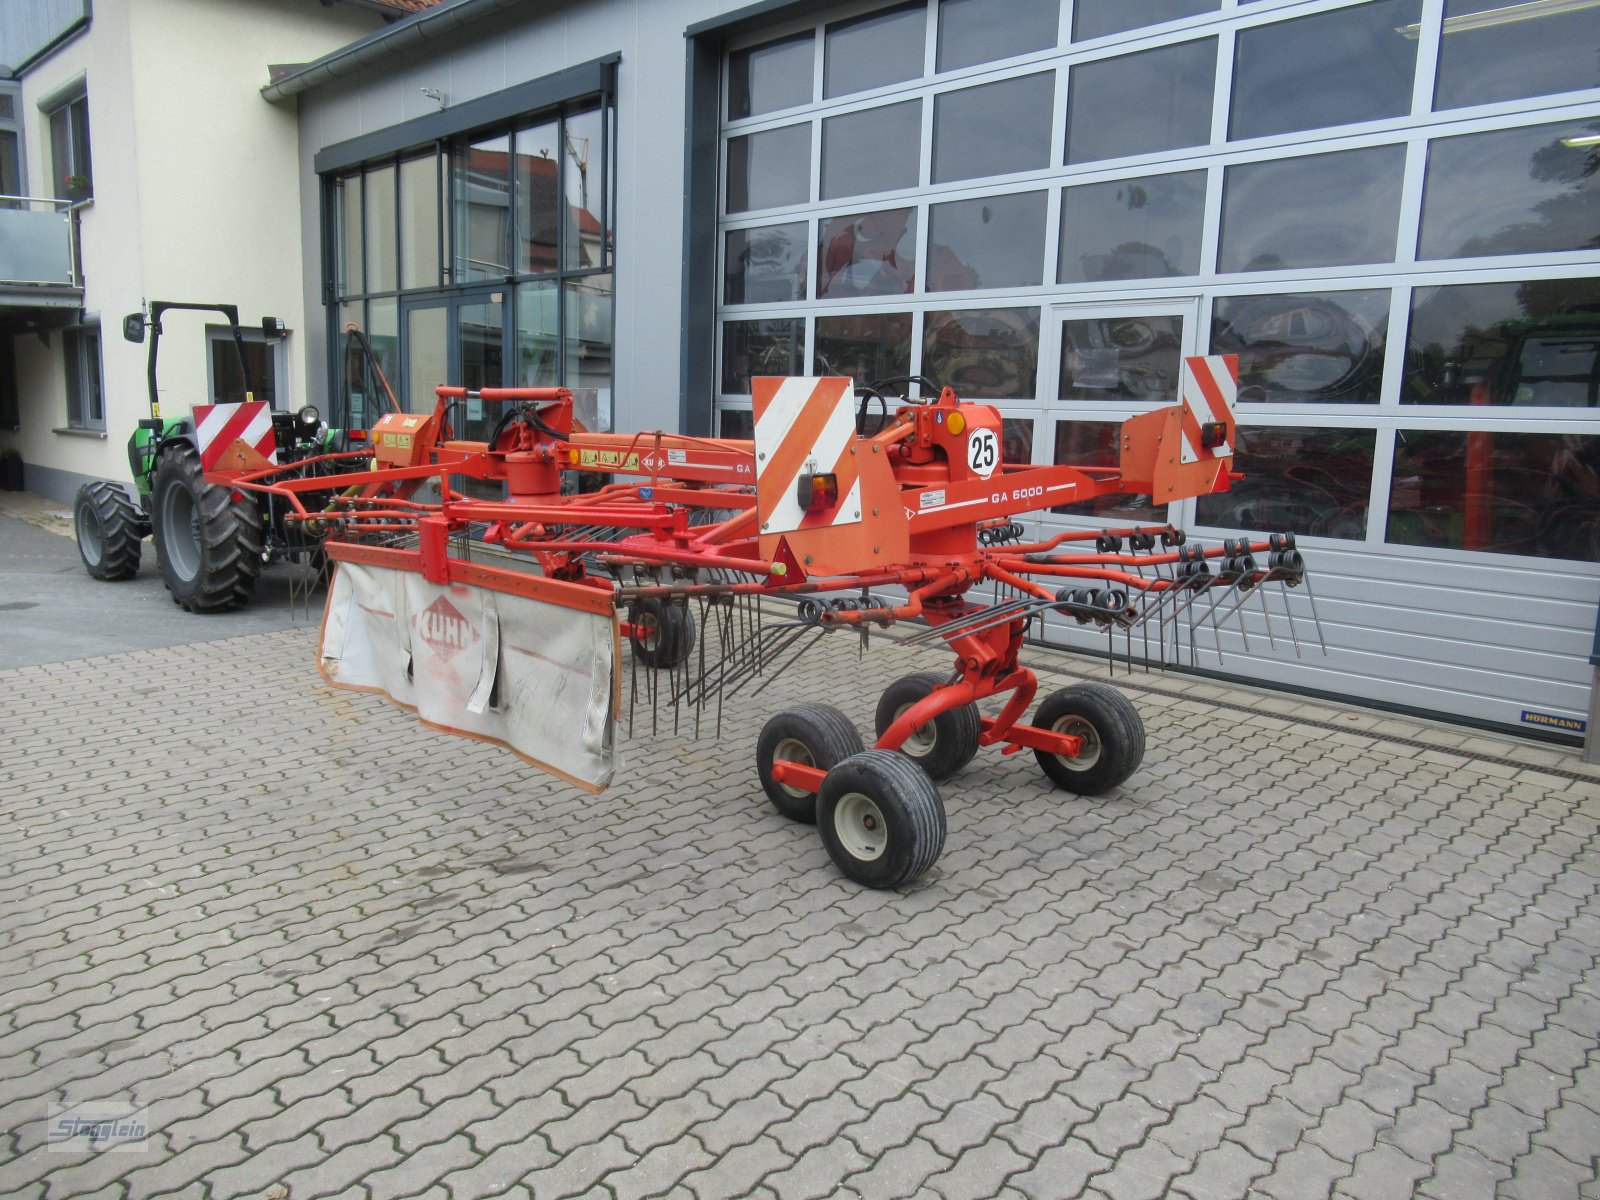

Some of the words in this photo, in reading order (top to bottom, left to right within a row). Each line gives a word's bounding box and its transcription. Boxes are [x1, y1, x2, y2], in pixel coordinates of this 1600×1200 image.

[971, 434, 994, 470] 25
[736, 463, 751, 473] GA
[991, 493, 1008, 504] GA
[1012, 485, 1043, 501] 6000
[415, 608, 475, 648] KUHN
